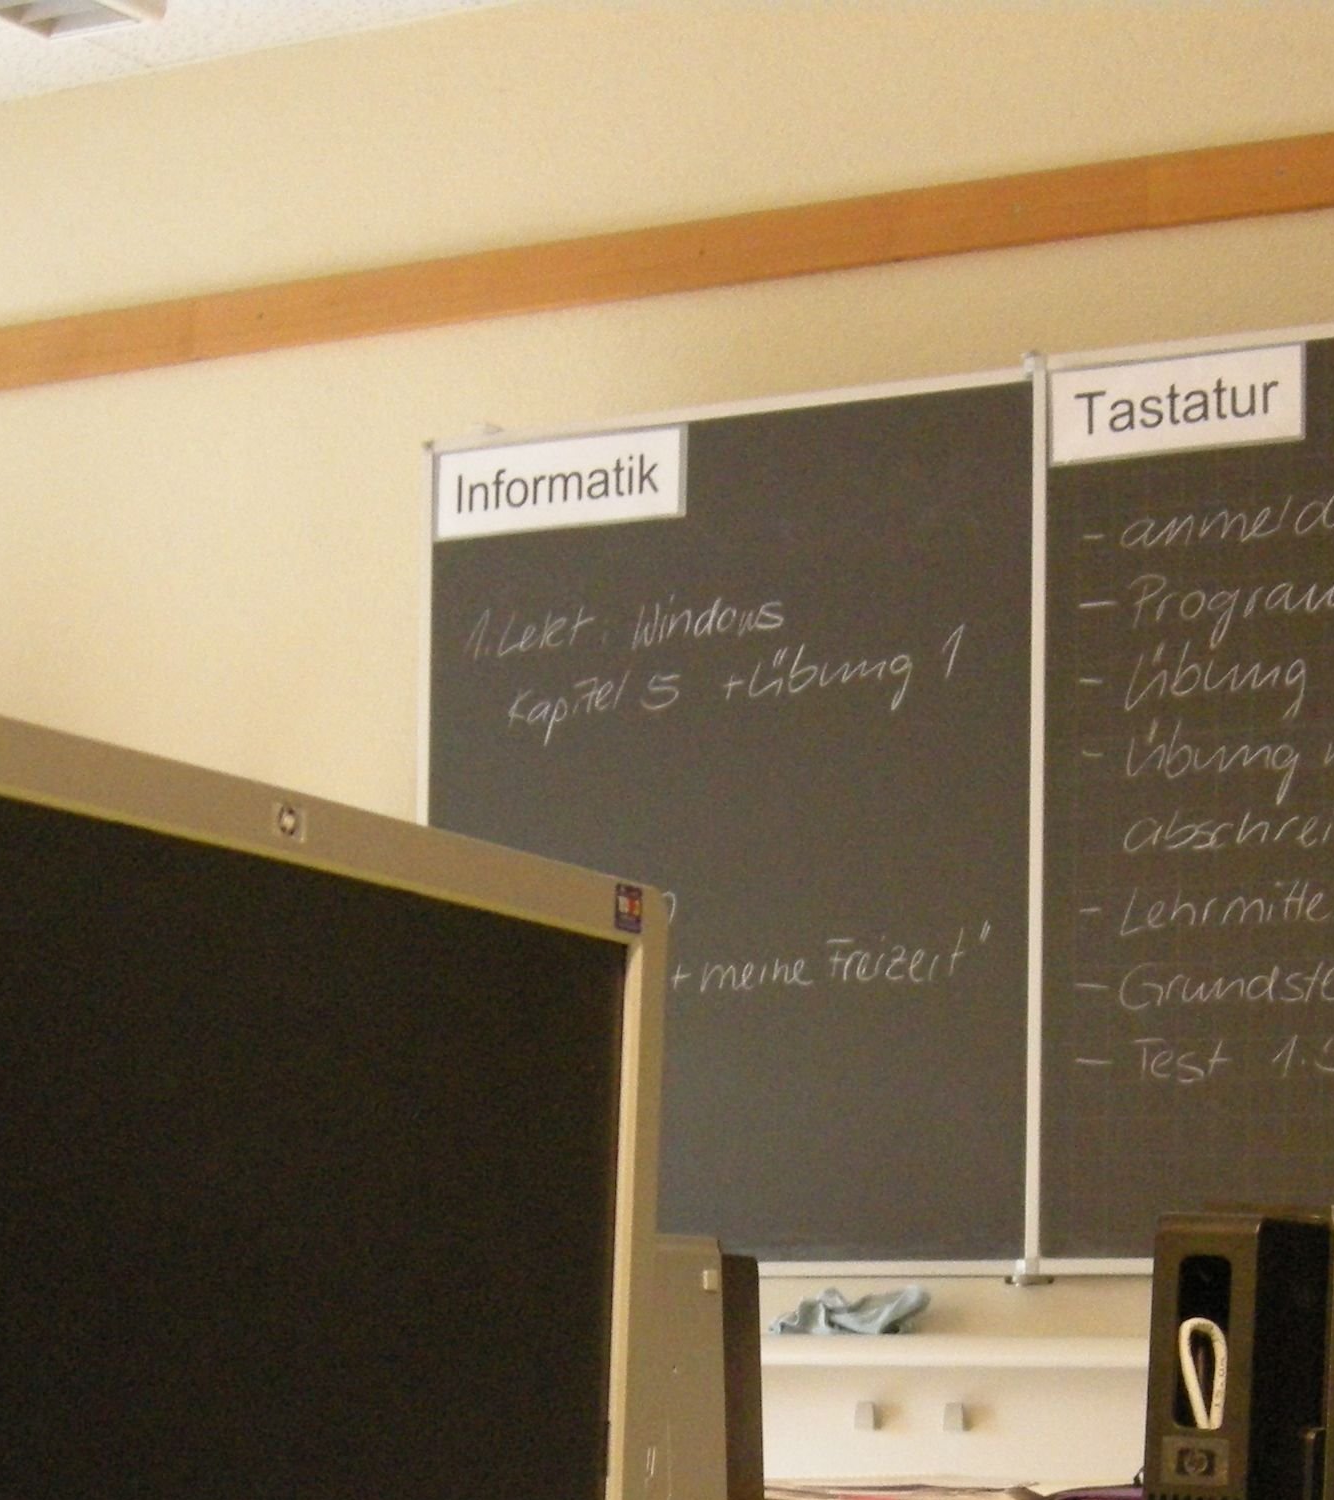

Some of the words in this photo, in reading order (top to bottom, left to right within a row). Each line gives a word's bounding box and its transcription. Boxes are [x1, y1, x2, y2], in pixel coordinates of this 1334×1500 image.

[1074, 375, 1279, 436] Tastatur
[456, 453, 659, 516] Informatik
[631, 594, 784, 650] Windows
[640, 673, 681, 711] 5
[1124, 642, 1307, 720] Übung
[1124, 718, 1299, 806] Übung
[1132, 1037, 1233, 1084] Test
